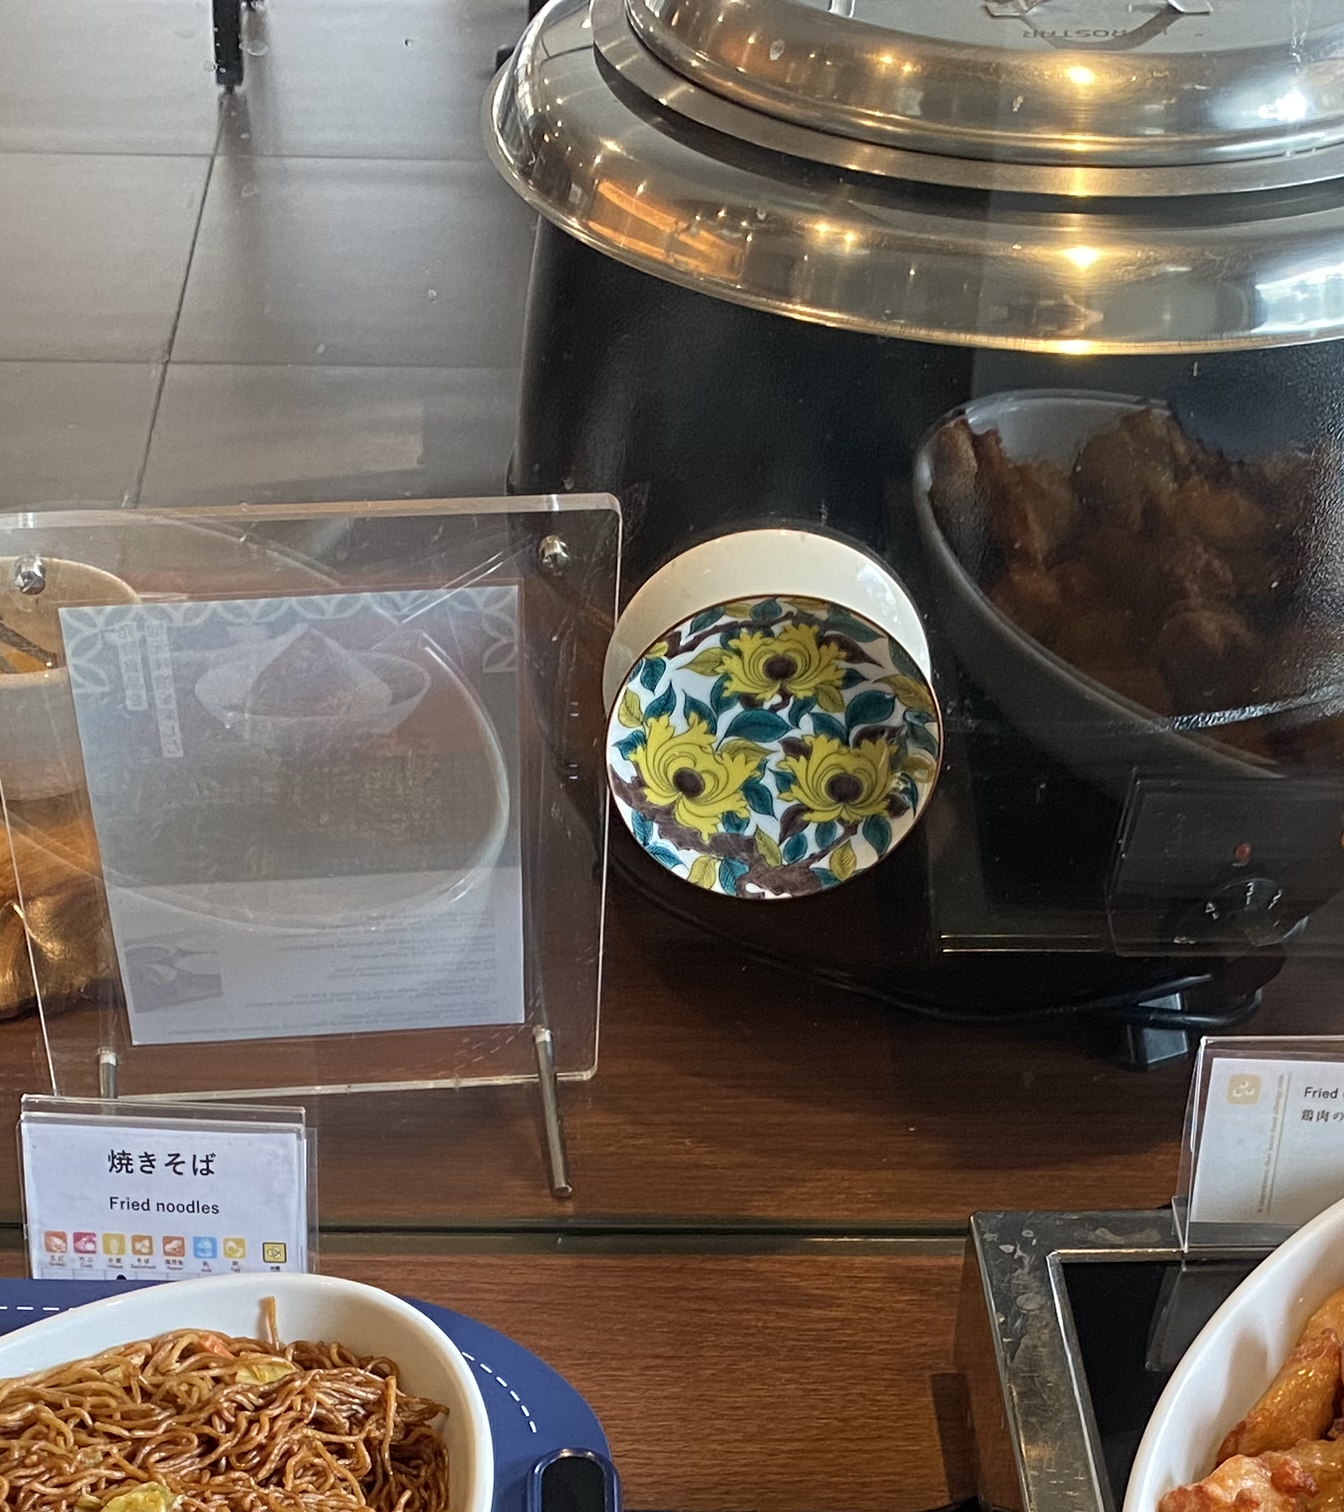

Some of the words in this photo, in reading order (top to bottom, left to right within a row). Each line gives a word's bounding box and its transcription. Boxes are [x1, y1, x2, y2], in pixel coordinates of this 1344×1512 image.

[1303, 1086, 1338, 1100] Fried
[108, 1149, 217, 1177] 焼きそば
[109, 1196, 150, 1212] Fried
[156, 1199, 220, 1215] noodles
